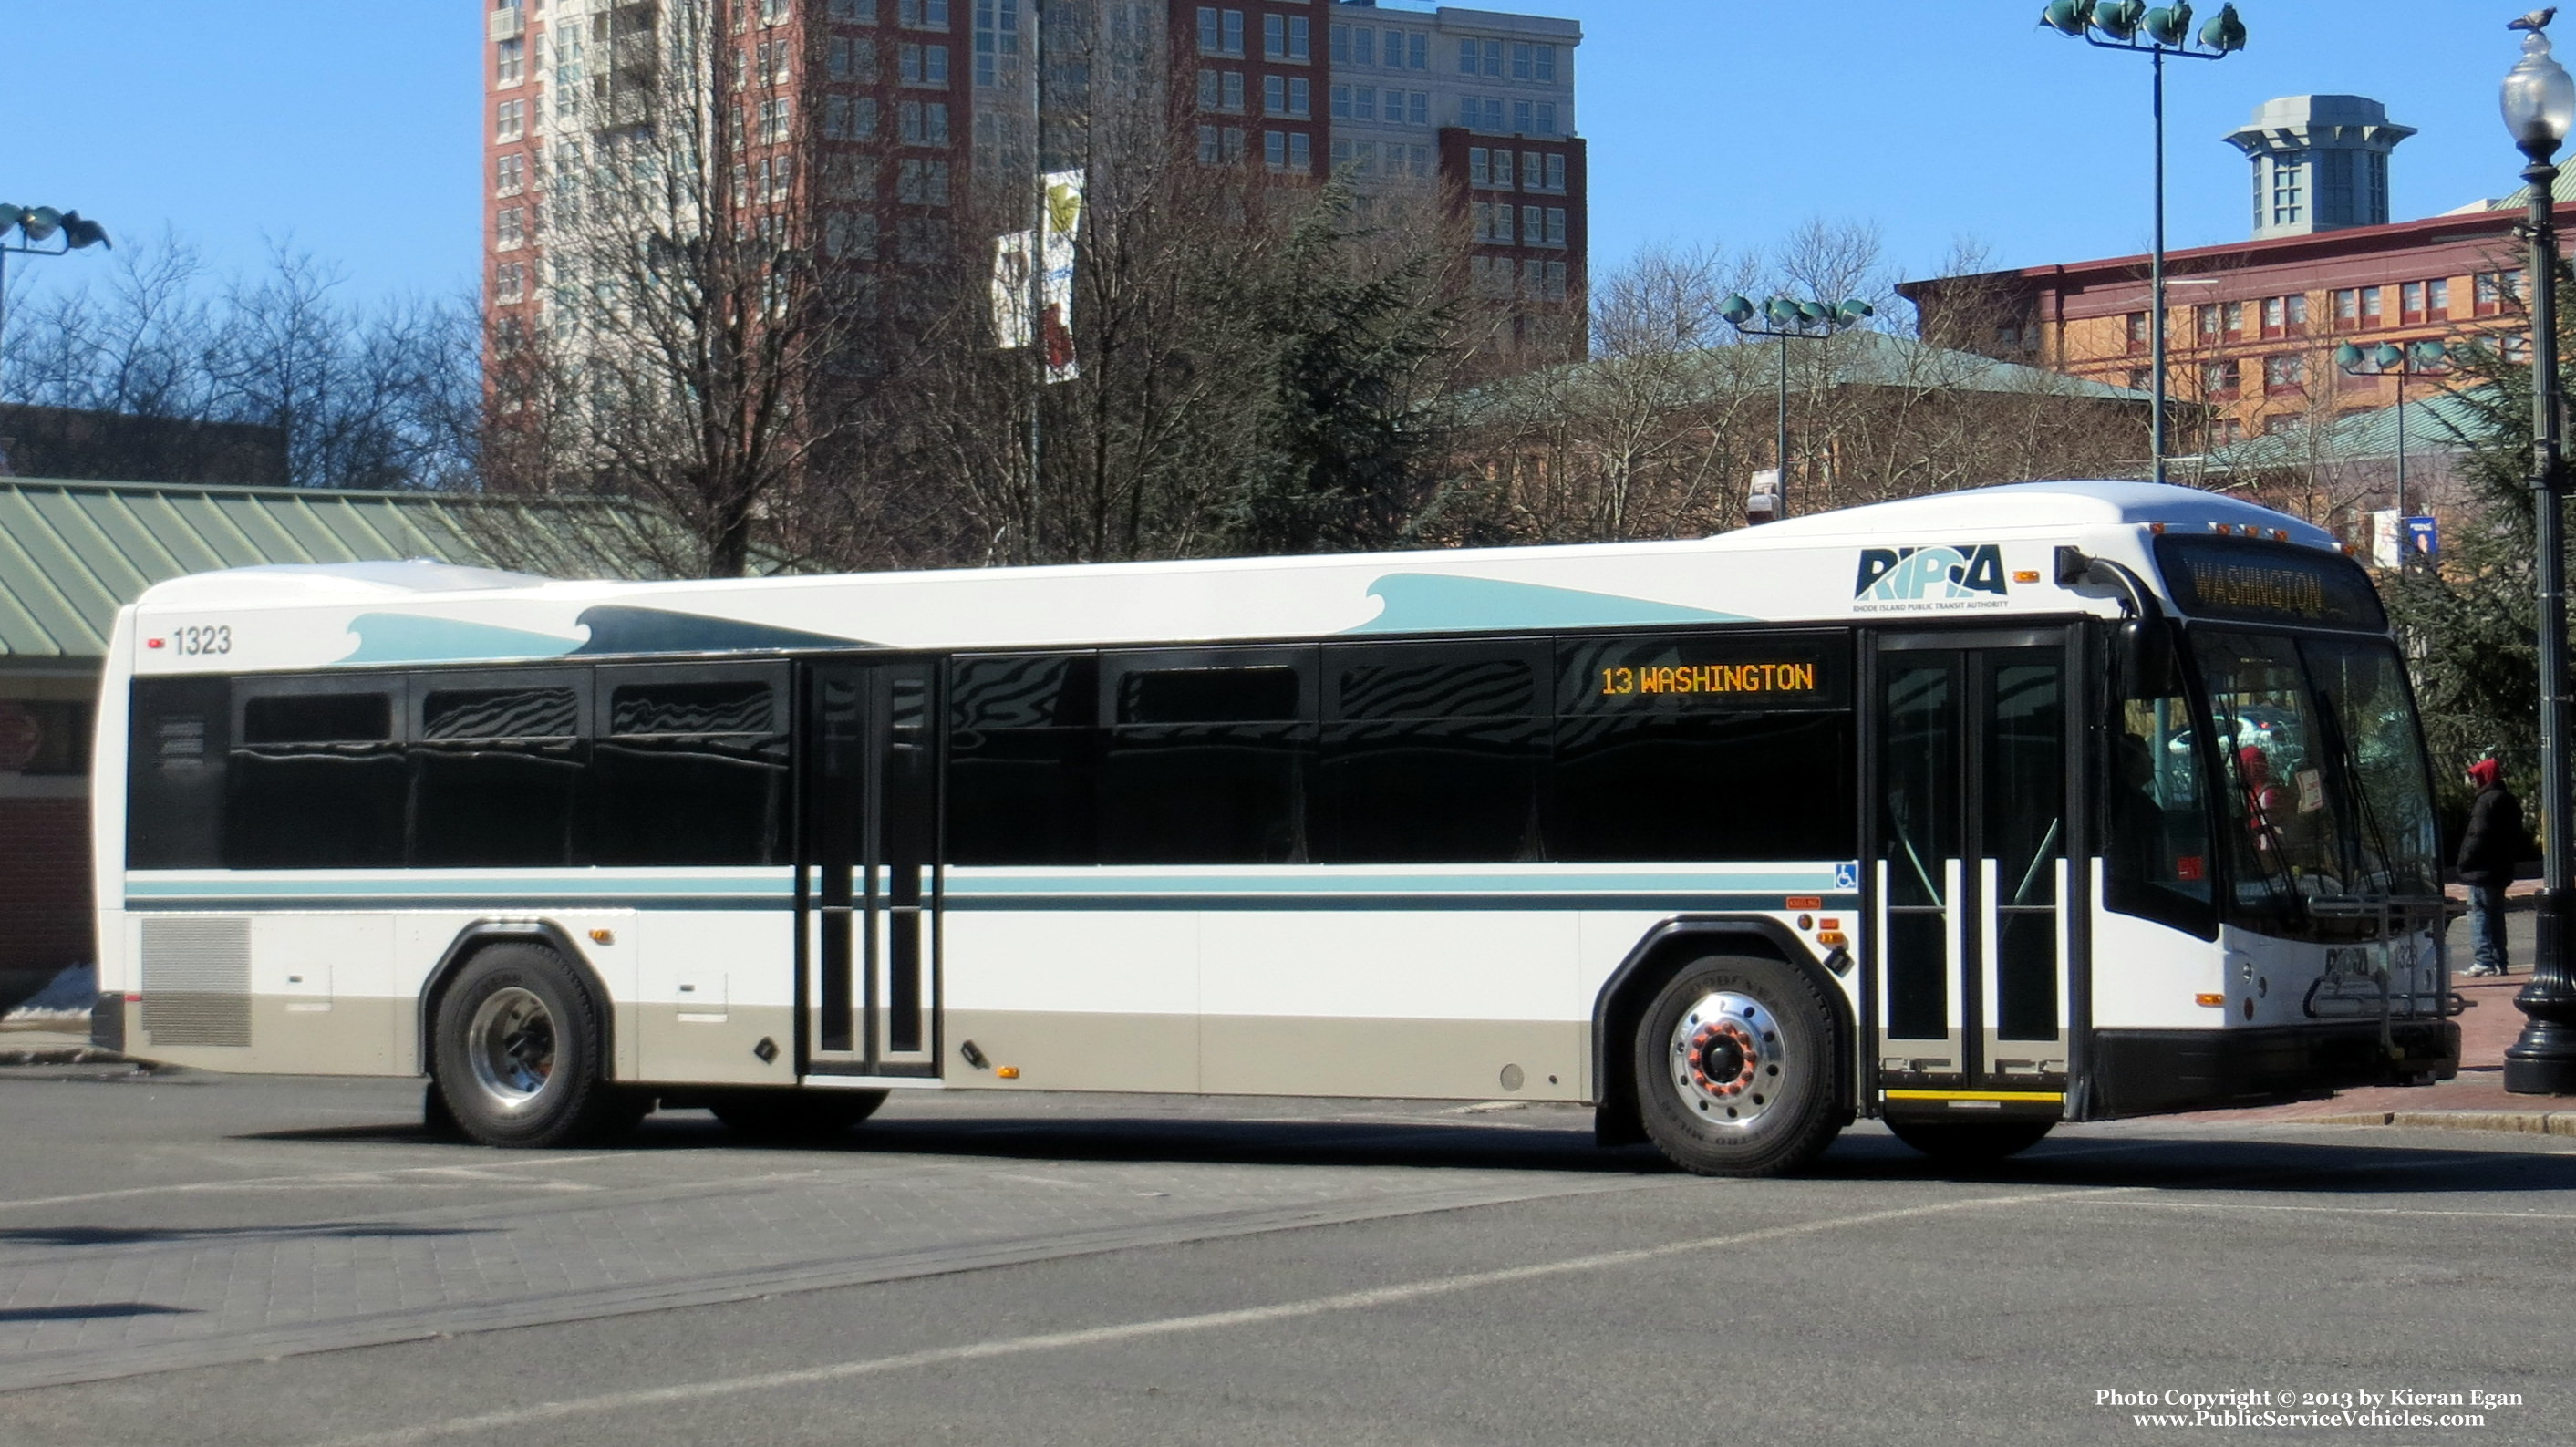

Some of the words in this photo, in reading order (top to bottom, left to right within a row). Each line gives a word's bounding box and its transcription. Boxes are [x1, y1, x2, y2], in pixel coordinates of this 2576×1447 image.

[1854, 544, 2008, 601] RIPTA
[2193, 561, 2323, 612] WASHINGTON
[1853, 605, 1878, 613] RHODE
[1879, 604, 1906, 612] ISLAND
[1908, 603, 1932, 611] PUBLIC
[1935, 602, 1965, 610] TRANSIT
[1967, 601, 2009, 609] AUTHORITY
[174, 625, 232, 656] 1323
[1602, 667, 1633, 694] 13
[1640, 663, 1813, 693] WASHINGTON
